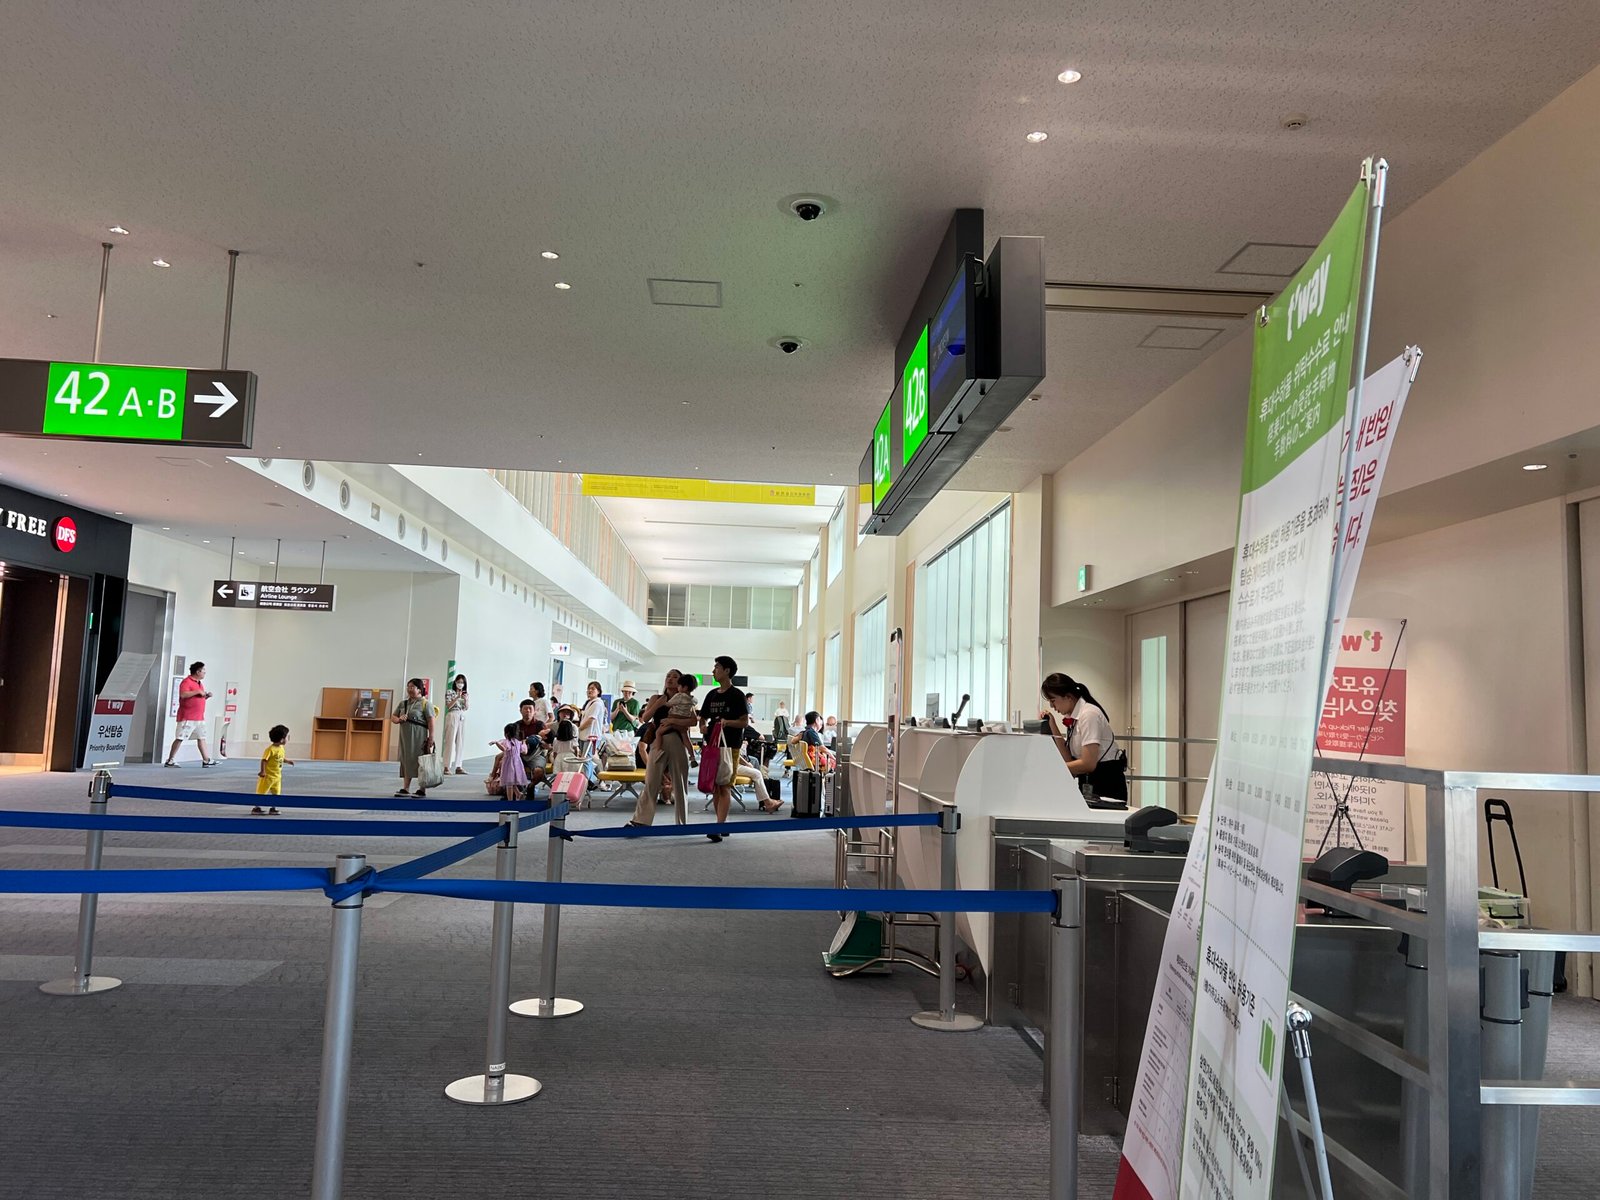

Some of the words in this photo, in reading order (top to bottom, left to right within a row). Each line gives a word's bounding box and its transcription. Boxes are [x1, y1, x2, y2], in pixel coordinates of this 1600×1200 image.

[1287, 253, 1331, 341] t'way
[54, 370, 110, 416] 42
[906, 367, 926, 436] 42B
[874, 433, 890, 487] 42A
[6, 510, 47, 537] FREE
[57, 525, 76, 544] DFS
[260, 585, 289, 594] 航空会社
[291, 586, 317, 594] ラウンジ
[89, 744, 105, 753] Priority
[106, 743, 126, 752] Boarding
[97, 725, 123, 738] 우선탑승
